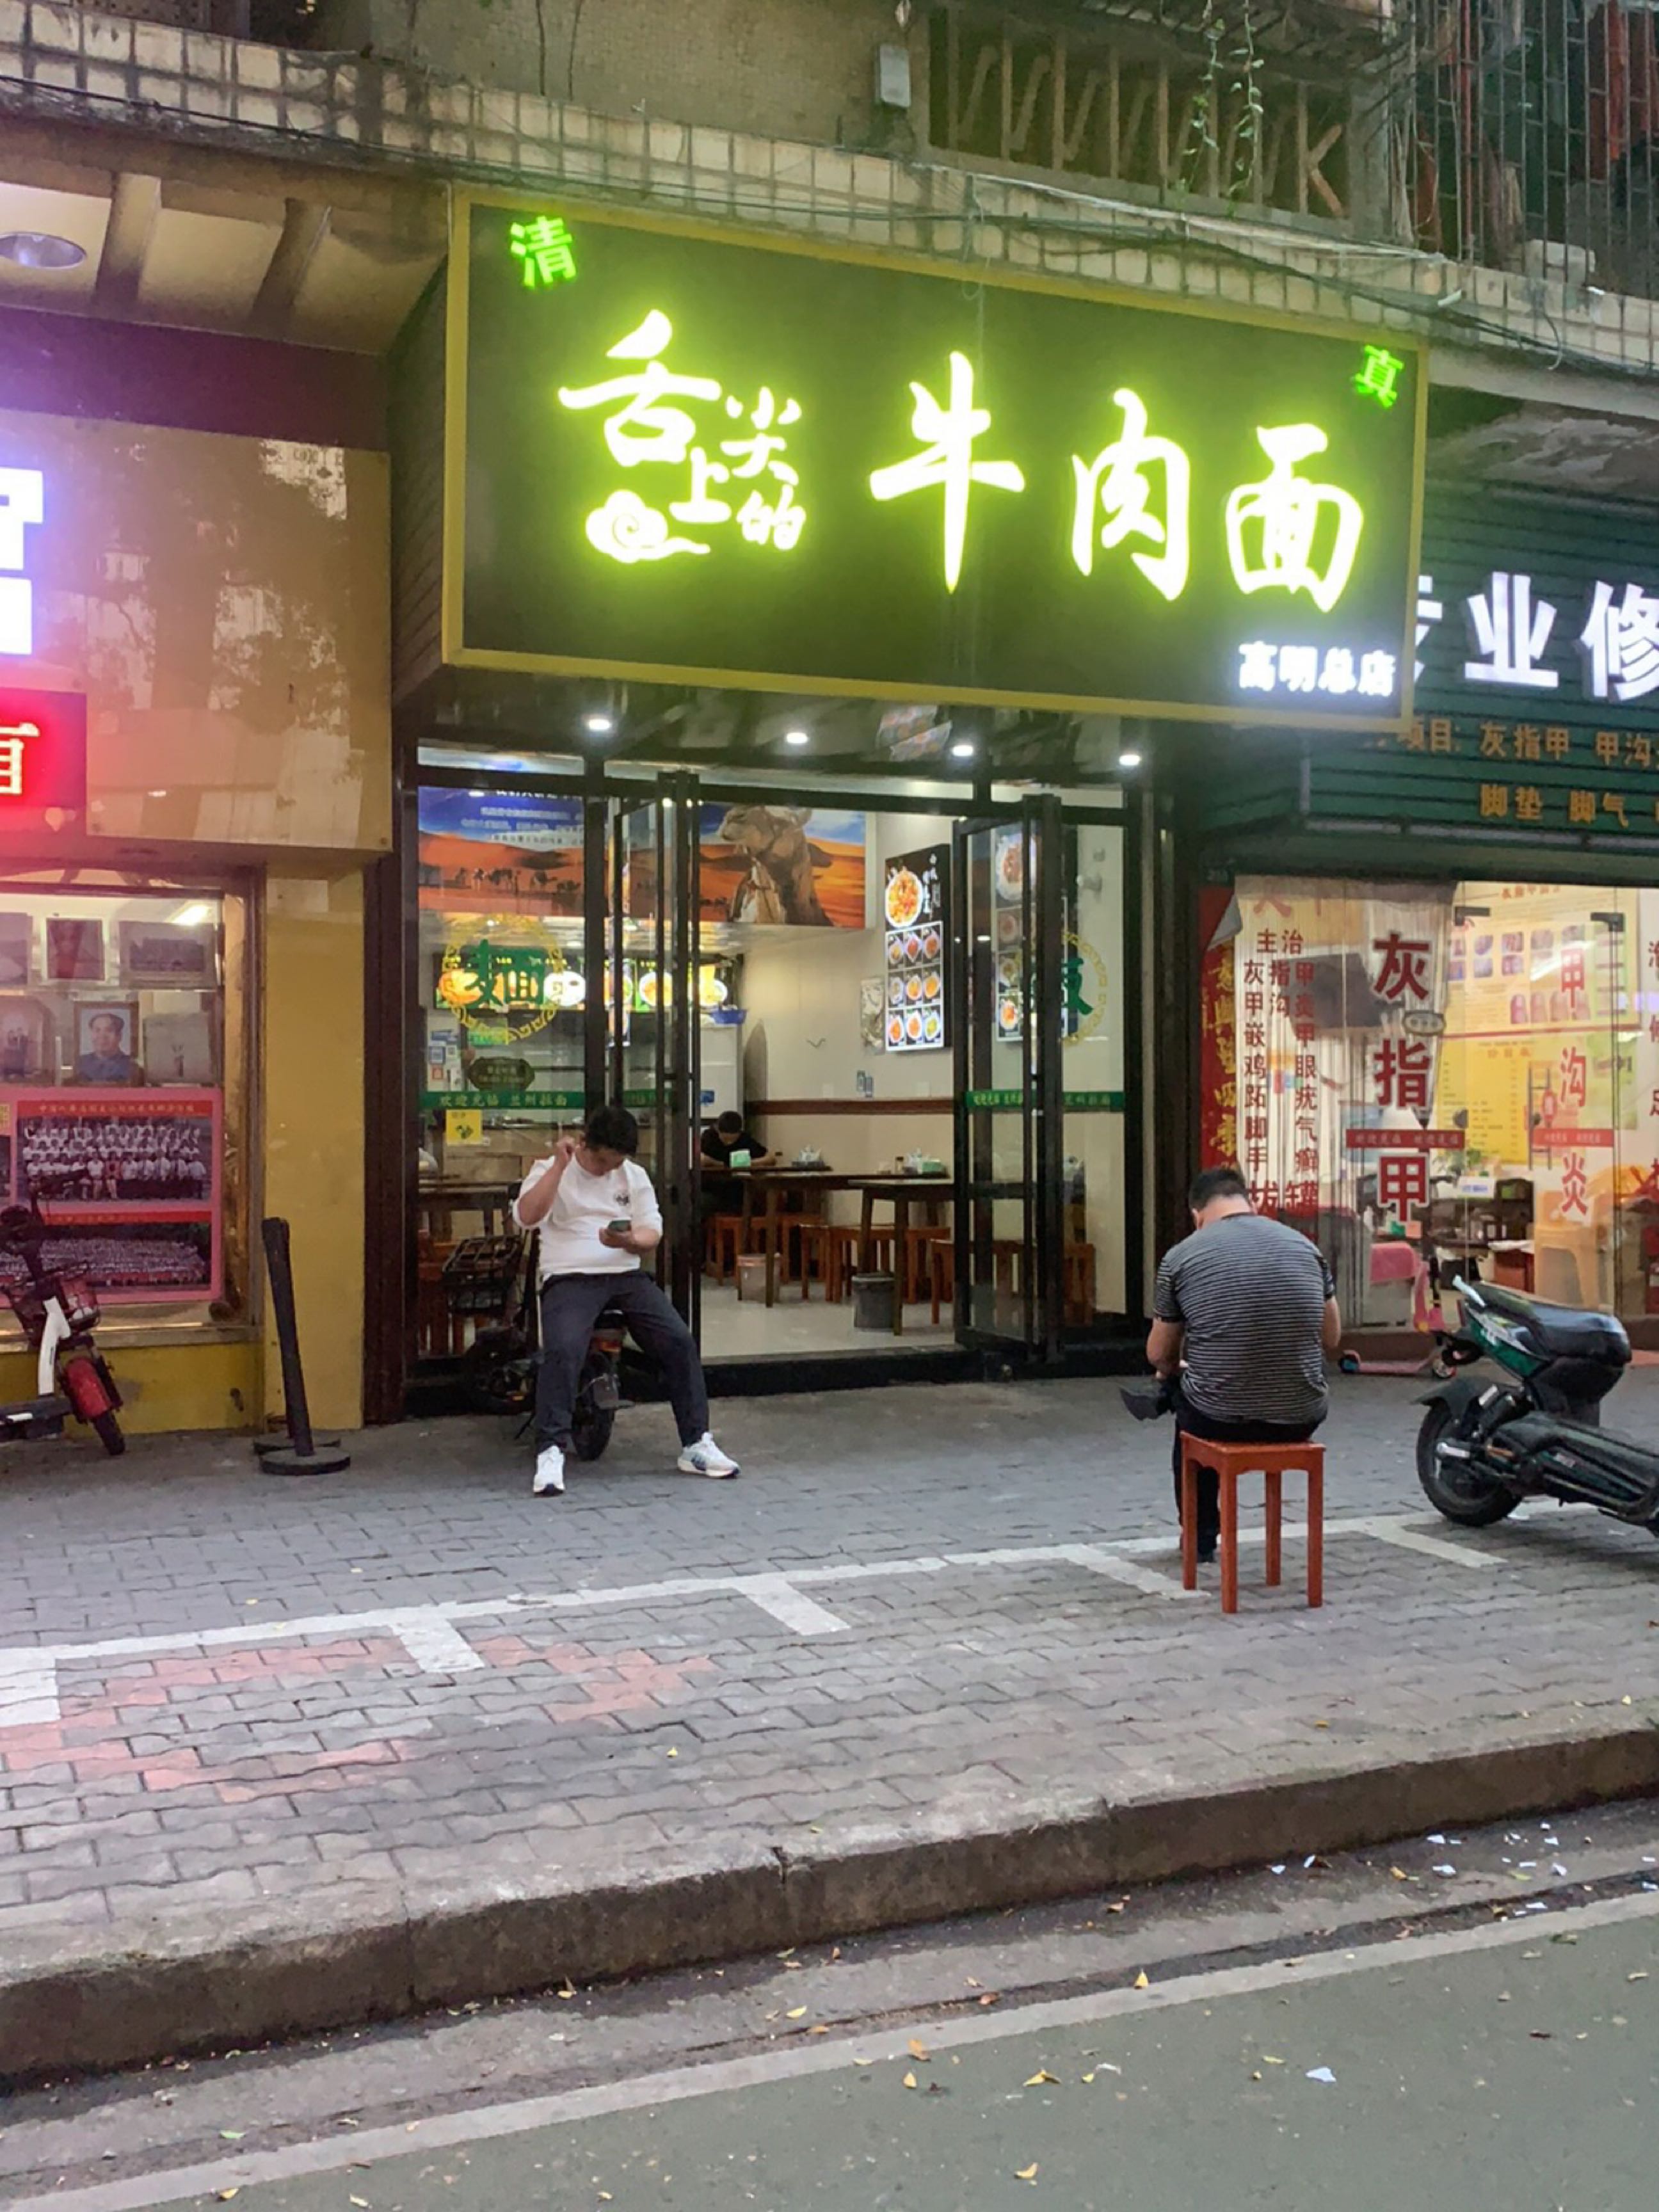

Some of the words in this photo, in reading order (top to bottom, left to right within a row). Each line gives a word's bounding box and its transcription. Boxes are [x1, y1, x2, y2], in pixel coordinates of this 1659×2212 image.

[510, 215, 577, 287] 清
[1355, 345, 1404, 408] 真
[869, 351, 1365, 613] 牛肉面
[1238, 641, 1396, 697] 高明总店
[1415, 572, 1659, 701] 业修
[1479, 721, 1569, 760] 灰指甲
[1596, 731, 1659, 769] 甲沟
[1244, 959, 1315, 986] 灰指甲
[1256, 928, 1304, 955] 主治
[1372, 931, 1431, 1222] 灰指甲
[1560, 949, 1588, 1215] 甲沟炎
